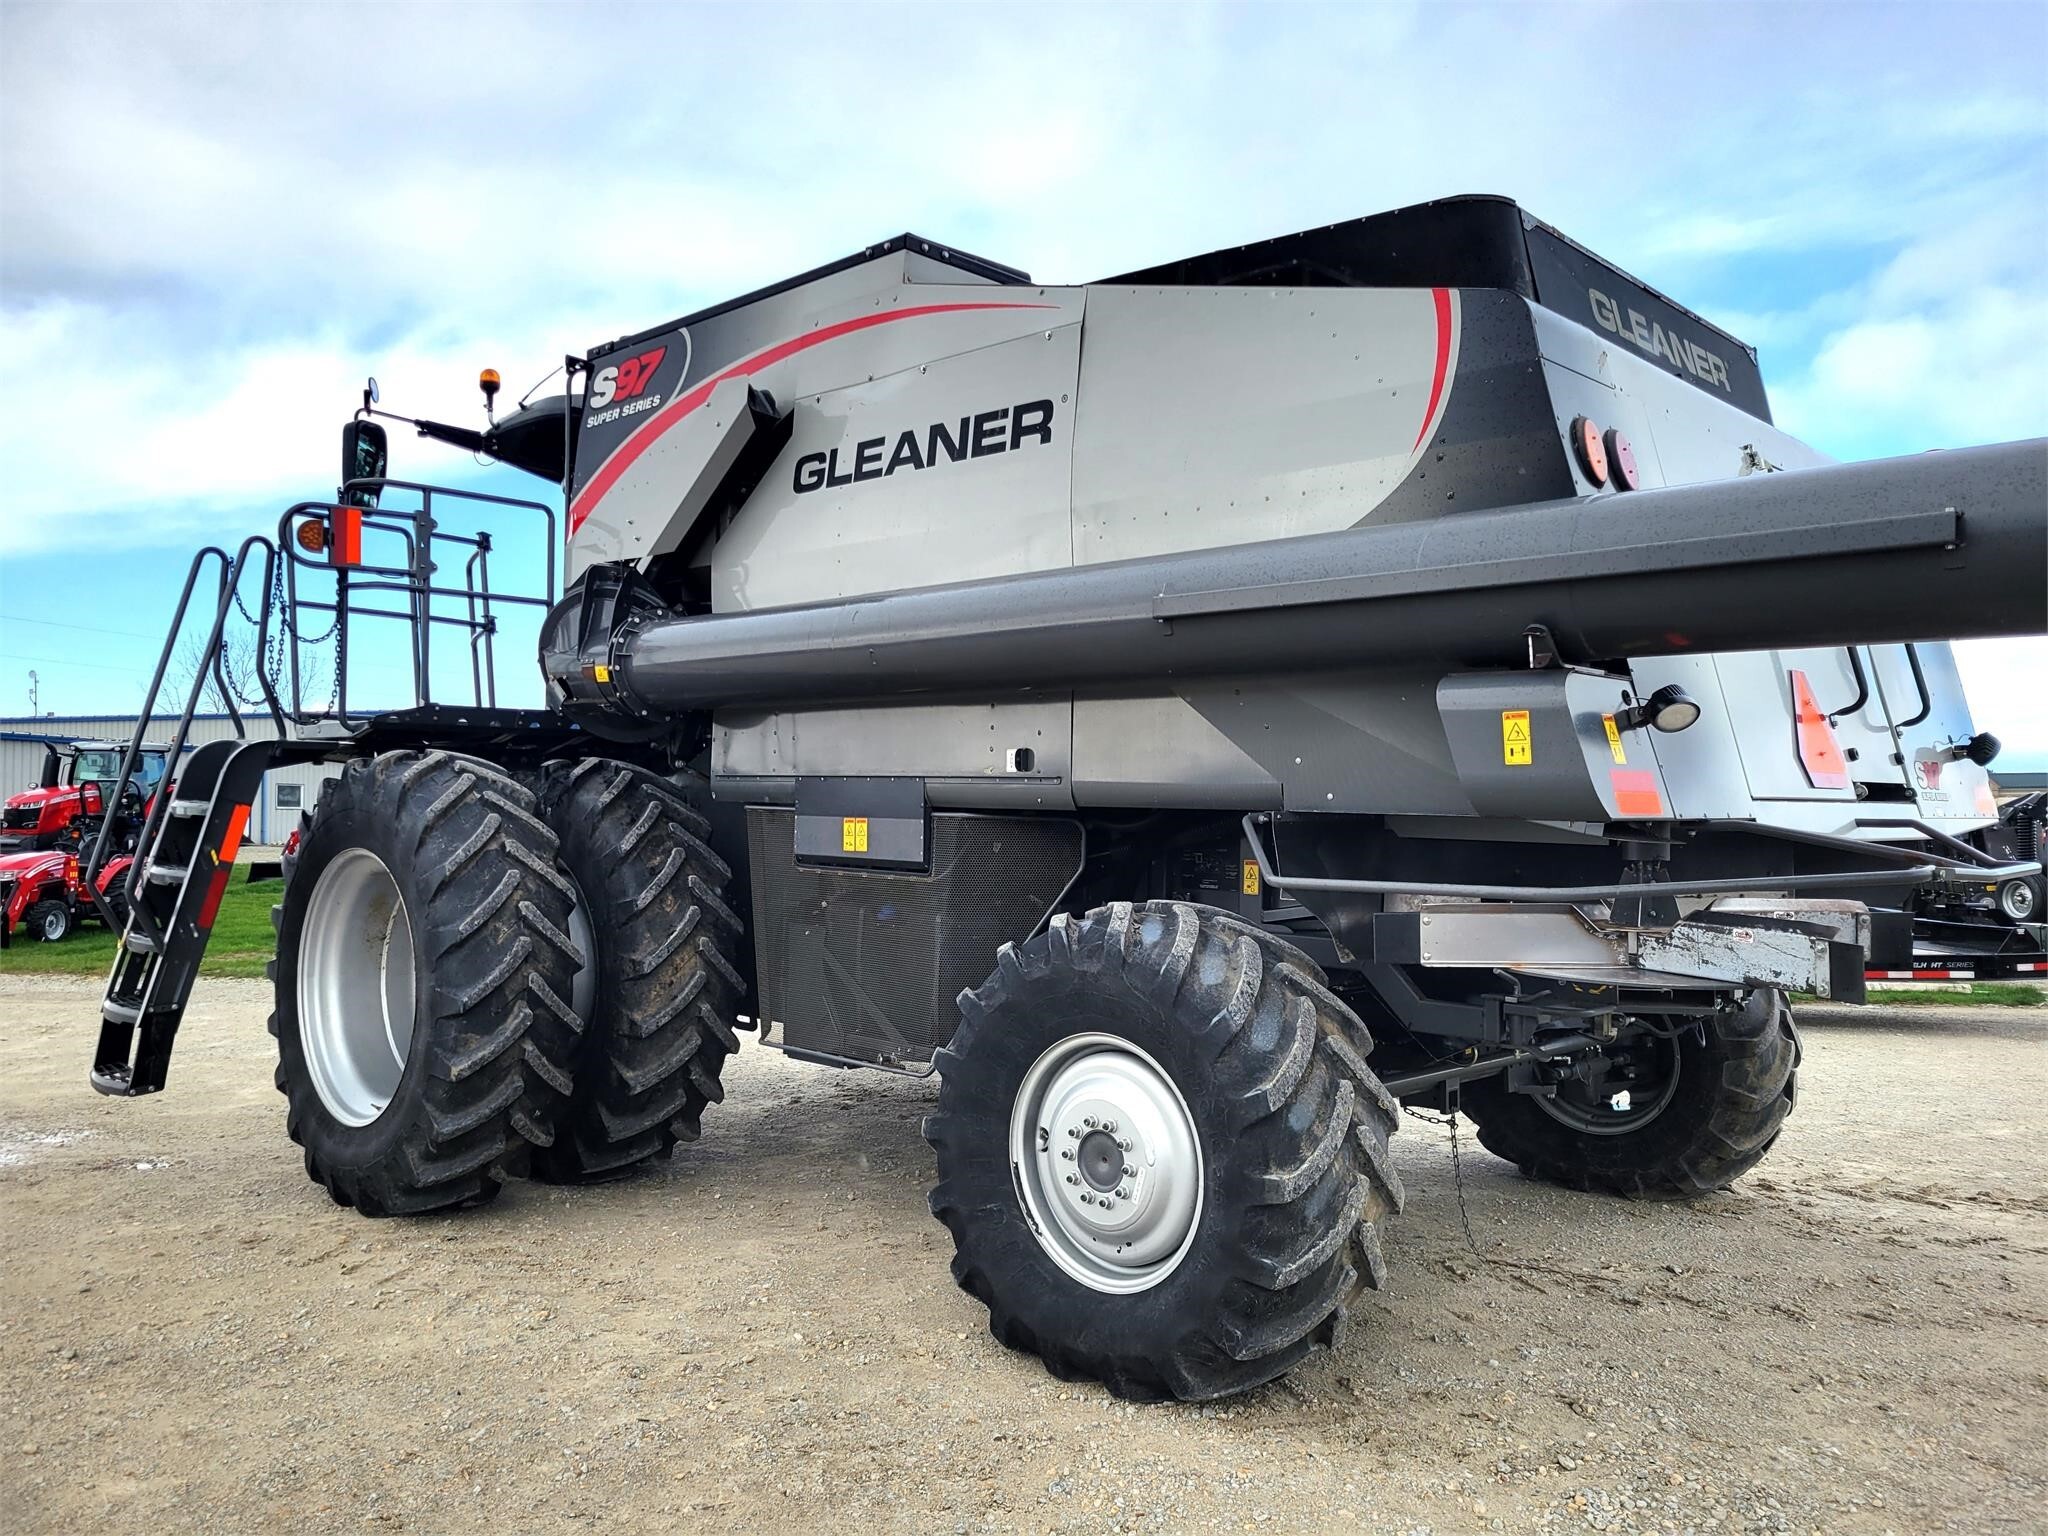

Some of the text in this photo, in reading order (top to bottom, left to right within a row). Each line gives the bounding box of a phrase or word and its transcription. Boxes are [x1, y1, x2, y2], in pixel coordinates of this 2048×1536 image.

[1588, 288, 1732, 393] GLEANER
[590, 346, 668, 409] S97
[586, 395, 661, 428] SUPER SERIES
[792, 399, 1054, 495] GLEANER
[1946, 961, 1975, 969] SERIES
